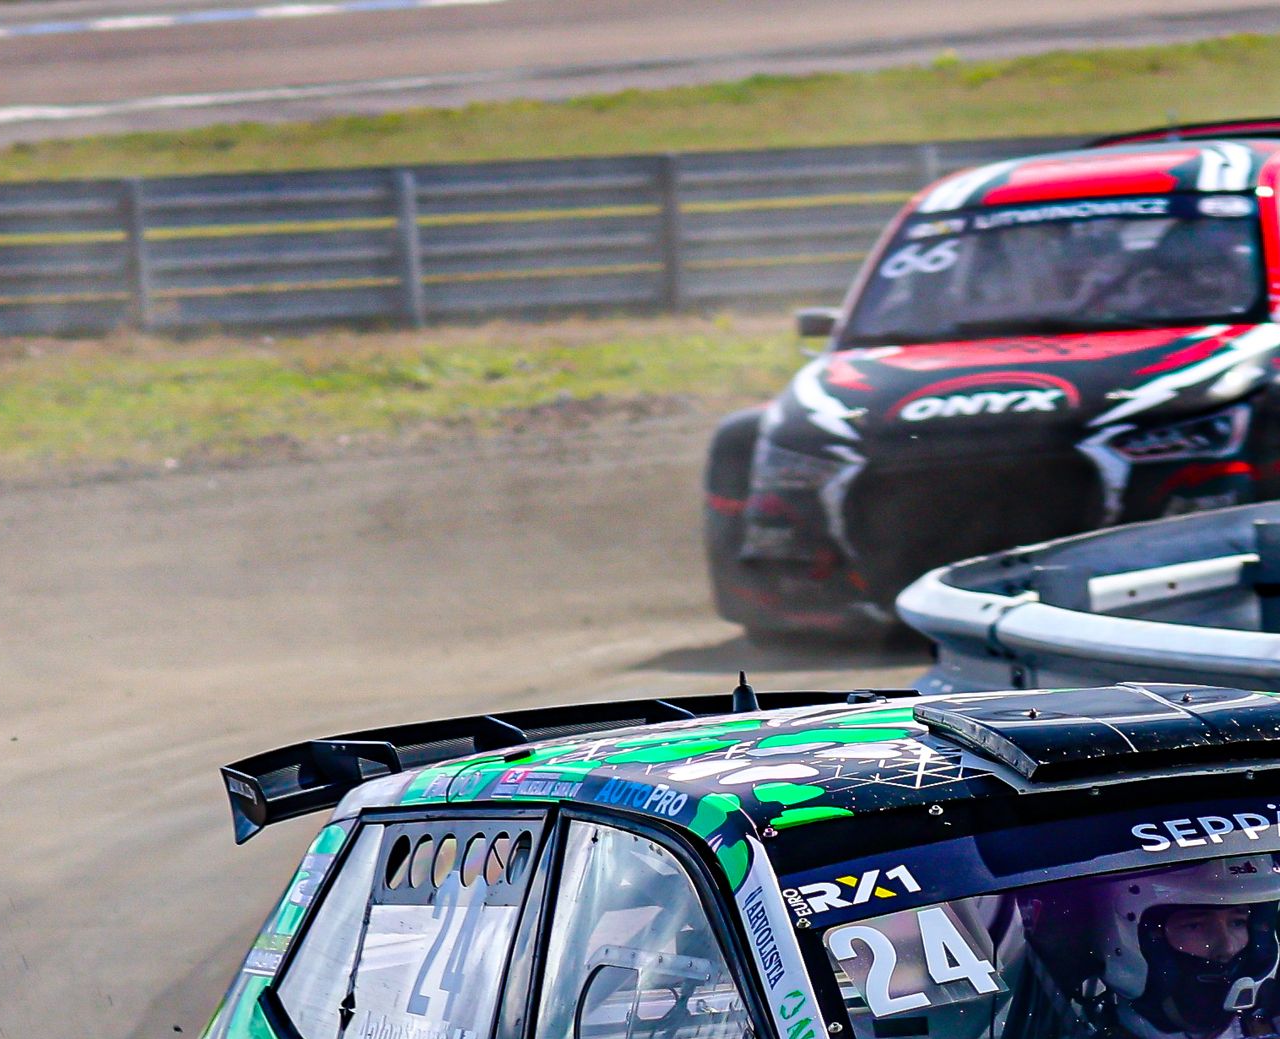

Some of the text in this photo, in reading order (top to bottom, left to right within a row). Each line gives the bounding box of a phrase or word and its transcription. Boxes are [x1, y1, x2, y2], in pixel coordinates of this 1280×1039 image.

[880, 239, 960, 278] 66
[900, 388, 1068, 421] ONYX
[783, 889, 812, 917] EURO
[407, 870, 487, 1022] 24
[829, 907, 999, 1017] 24
